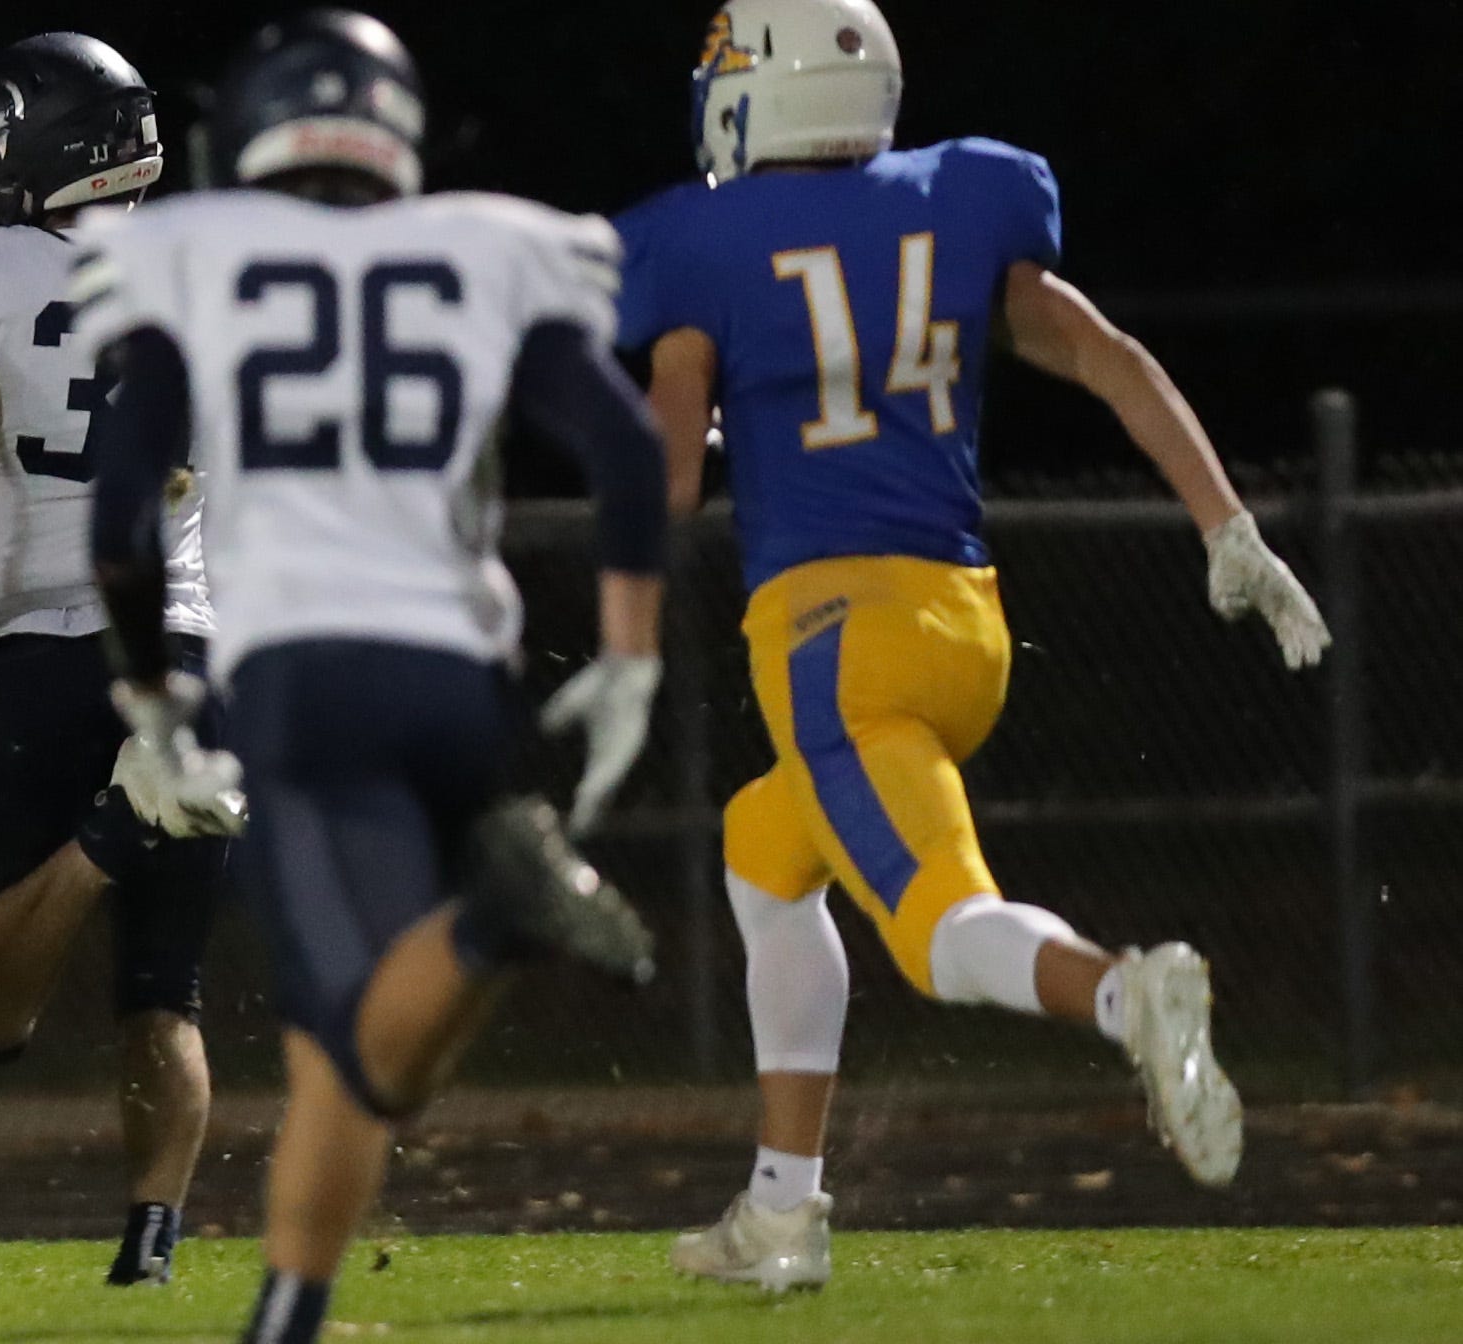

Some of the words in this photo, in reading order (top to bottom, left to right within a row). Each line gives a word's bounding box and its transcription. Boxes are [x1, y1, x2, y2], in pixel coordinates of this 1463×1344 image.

[89, 144, 108, 164] JJ
[237, 262, 463, 470] 26
[771, 230, 961, 452] 14
